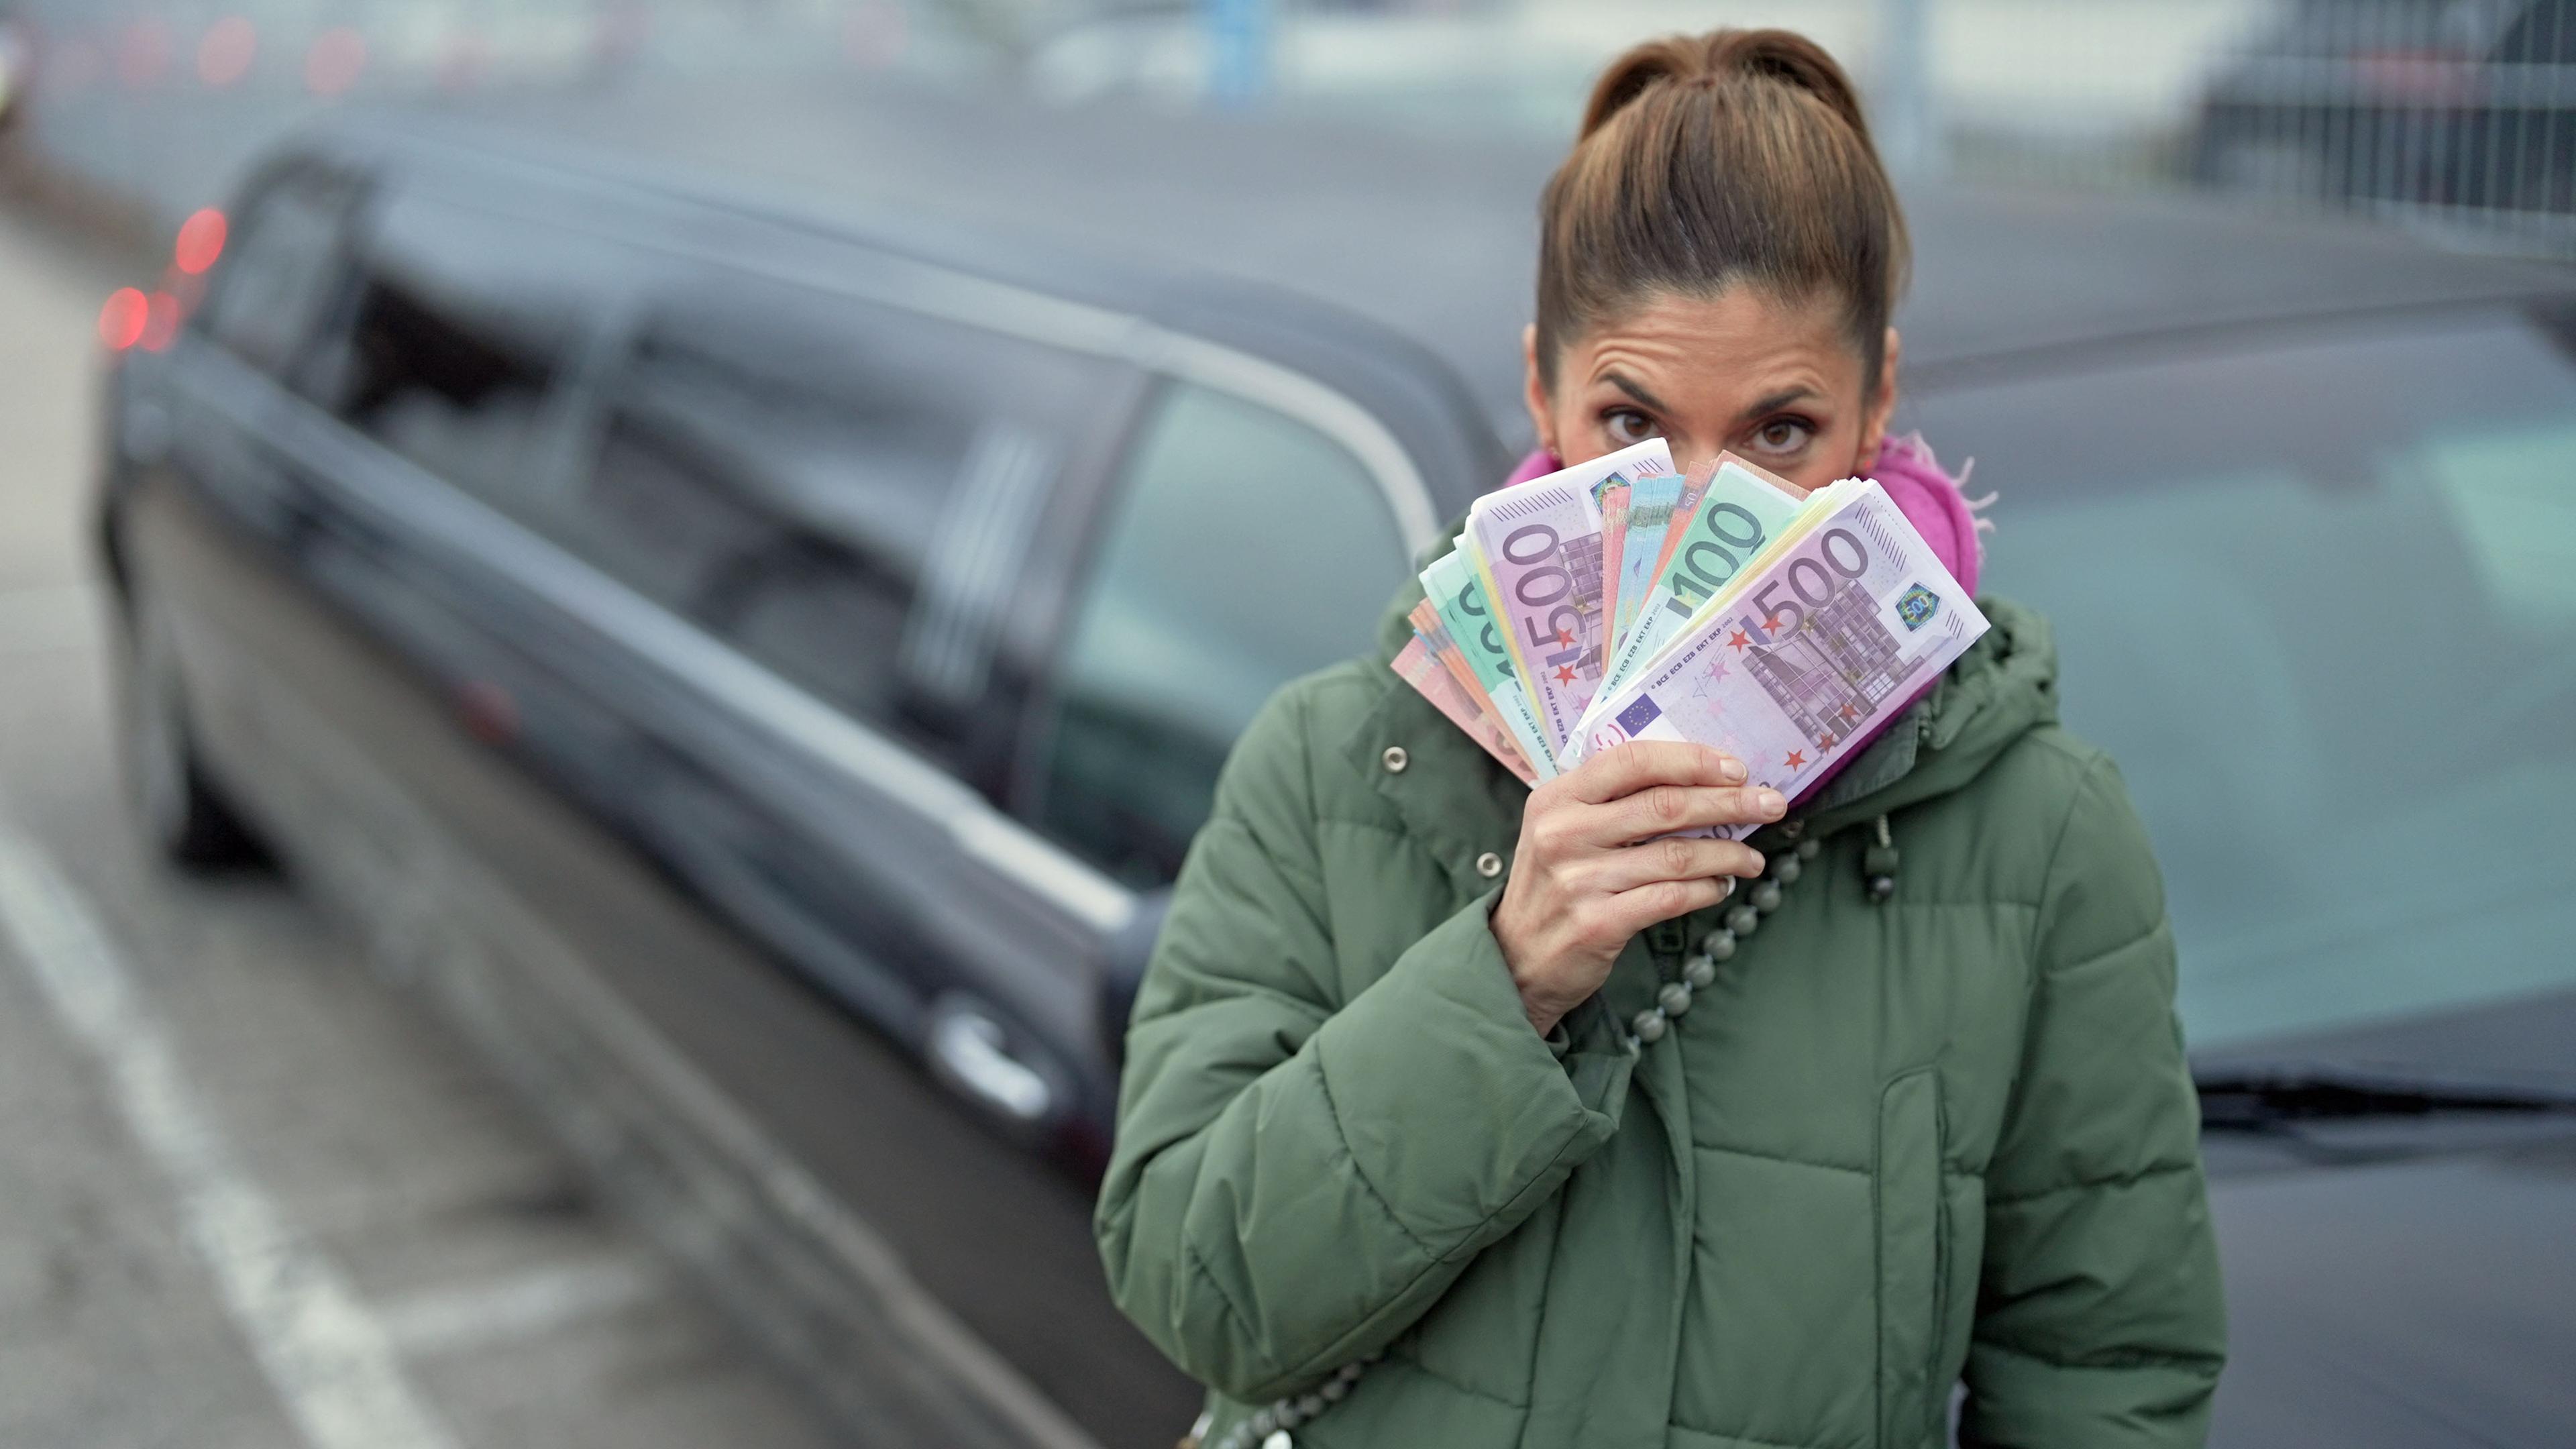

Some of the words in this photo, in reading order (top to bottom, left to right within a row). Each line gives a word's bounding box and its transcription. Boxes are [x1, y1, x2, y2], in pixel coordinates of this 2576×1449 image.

[1672, 502, 1762, 599] 100
[1503, 524, 1587, 647] 500
[1752, 528, 1869, 641] 500
[1905, 595, 1929, 619] 500
[1611, 674, 1621, 687] BCE
[1619, 659, 1629, 672] ECB
[1627, 645, 1638, 658] EZB
[1635, 631, 1646, 643] EKT
[1644, 616, 1654, 630] EKP
[1656, 674, 1670, 686] BCE
[1669, 662, 1683, 675] ECB
[1682, 651, 1696, 663] EZB
[1696, 639, 1709, 652] EKT
[1709, 627, 1721, 641] EKP
[1722, 616, 1734, 628] 2002
[1546, 686, 1554, 700] EKP
[1520, 708, 1530, 720] EKP
[1550, 702, 1560, 716] EKT
[1528, 722, 1538, 734] EKT
[1556, 718, 1565, 732] EZB
[1560, 735, 1568, 747] CB
